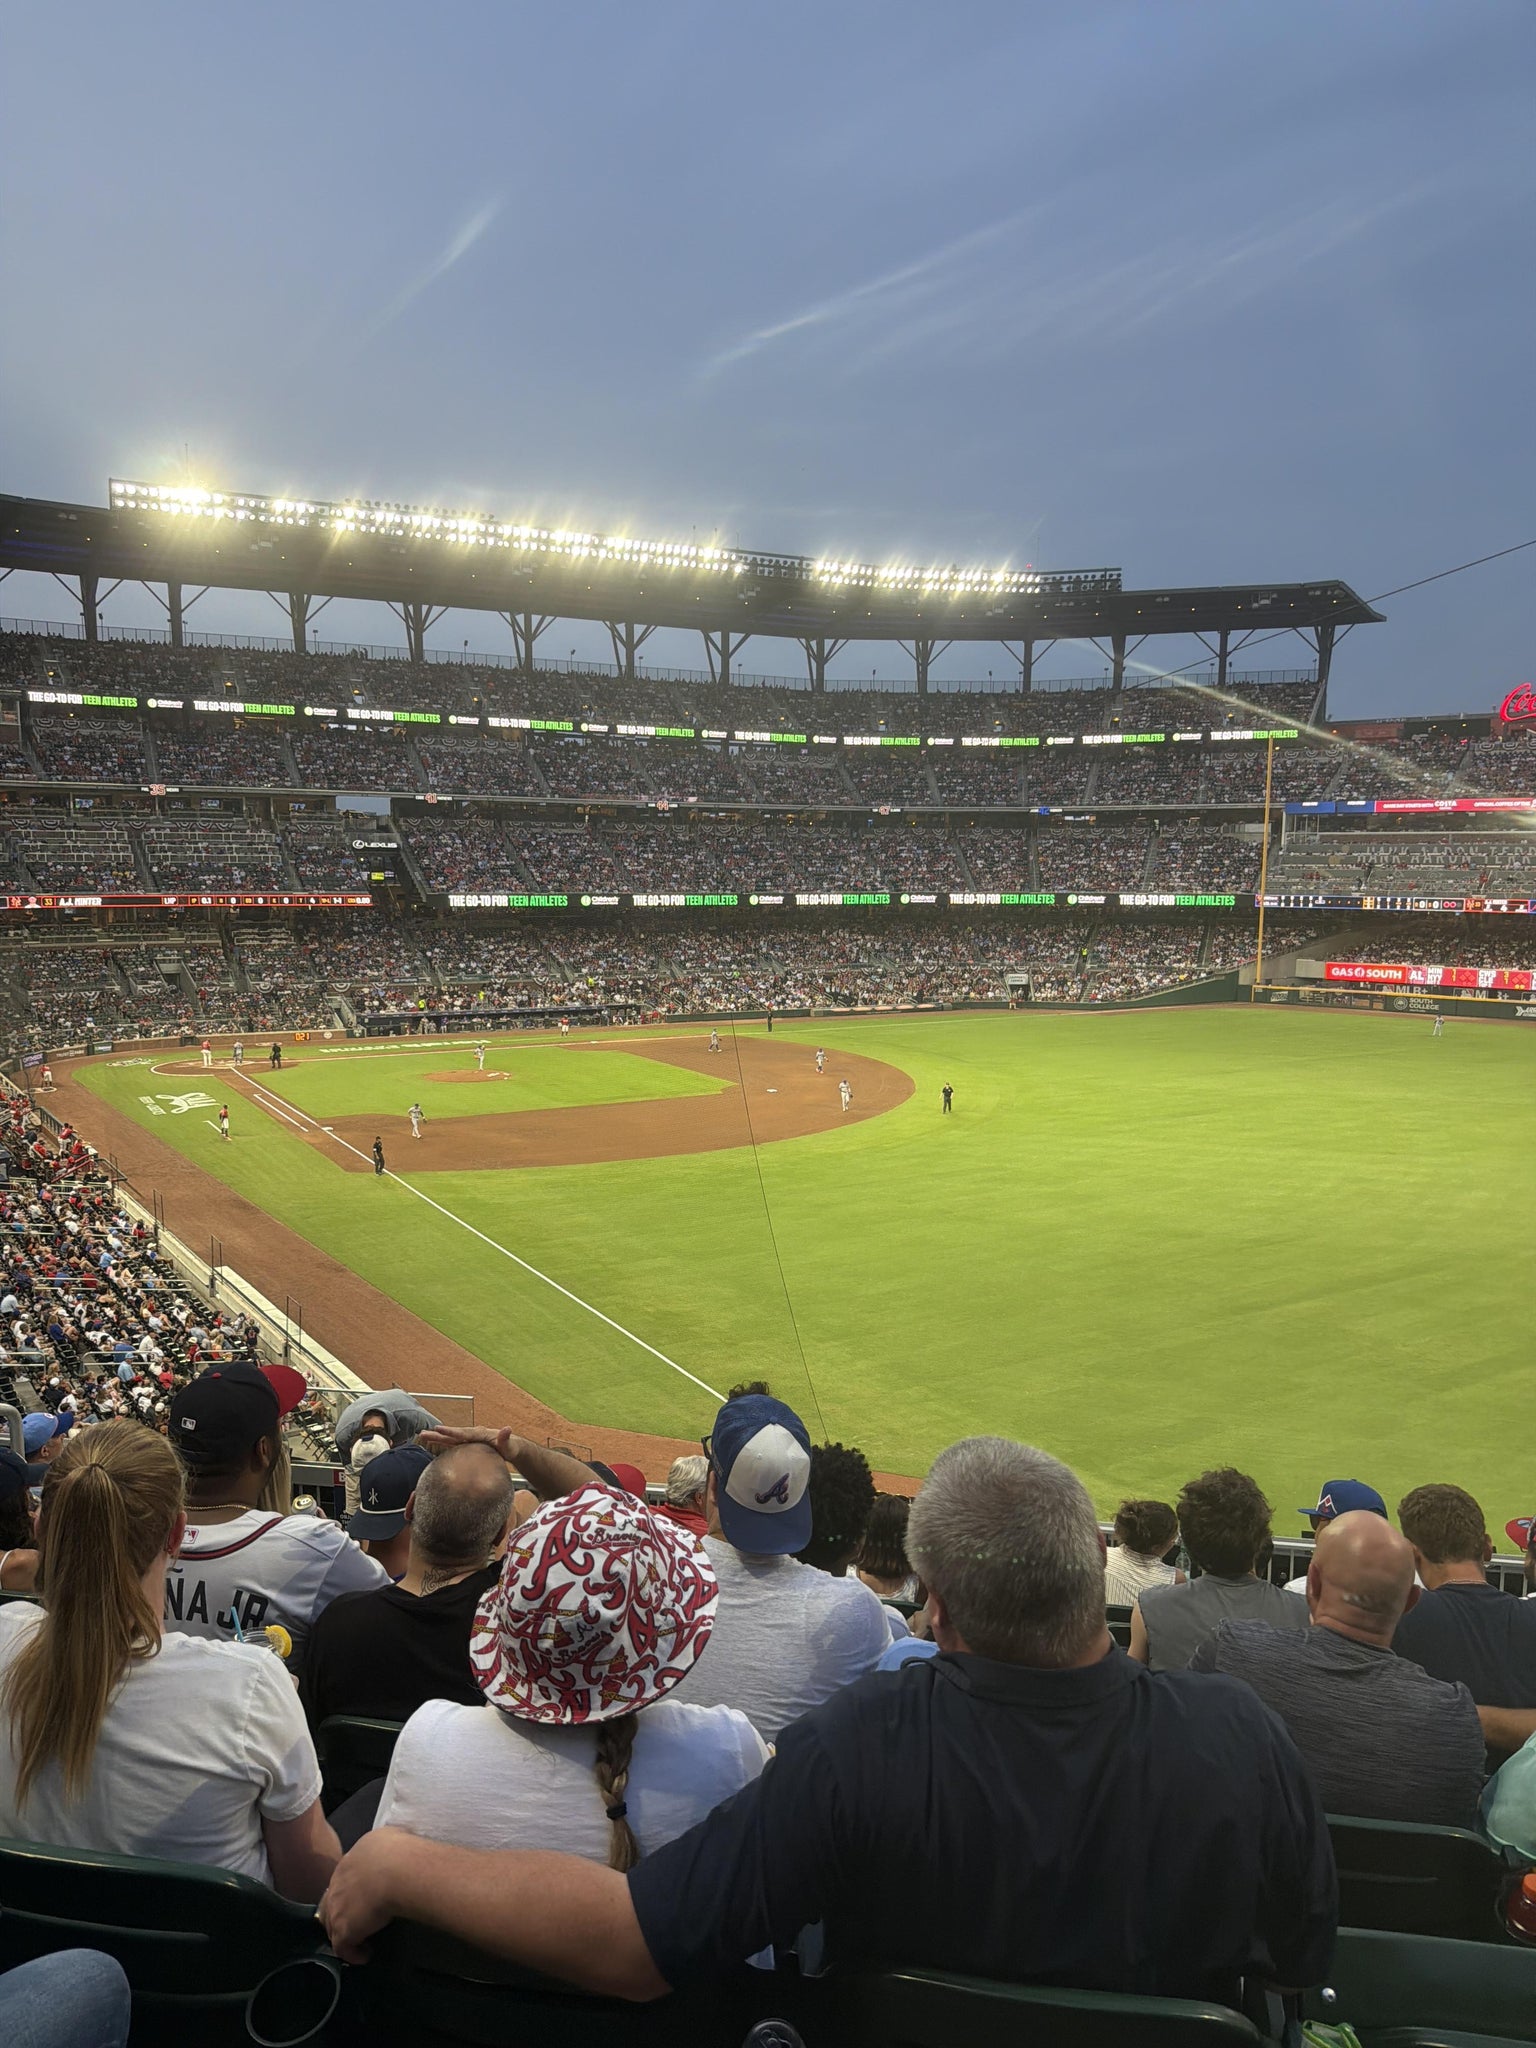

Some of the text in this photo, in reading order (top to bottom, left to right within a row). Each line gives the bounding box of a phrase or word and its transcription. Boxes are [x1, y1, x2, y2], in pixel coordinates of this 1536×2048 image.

[28, 691, 138, 706] THE GO-TO FOR TEEN ATHLETES
[194, 701, 295, 714] THE GO-TO FOR TEEN ATHLETES
[347, 709, 440, 722] THE GO-TO FOR TEEN ATHLETES
[488, 717, 573, 730] THE GO-TO FOR TEEN ATHLETES
[617, 725, 628, 734] THE
[628, 725, 644, 735] GO-TO
[645, 726, 655, 735] FOR
[1211, 732, 1223, 740] THE
[1223, 731, 1241, 740] GO-TO
[1242, 731, 1253, 739] FOR
[735, 731, 745, 740] THE
[745, 732, 760, 740] GO-TO
[761, 732, 770, 741] FOR
[783, 734, 806, 742] ATHLETES
[844, 737, 854, 745] THE
[855, 737, 870, 745] GO-TO
[871, 737, 880, 745] FOR
[962, 737, 972, 746] THE
[973, 737, 989, 746] GO-TO
[989, 738, 999, 746] FOR
[1082, 736, 1094, 744] THE
[1094, 735, 1111, 744] GO-TO
[1112, 735, 1122, 743] FOR
[150, 784, 166, 795] 35
[59, 898, 73, 906] A.J.
[74, 898, 102, 906] MINTER
[448, 895, 568, 906] THE GO-TO FOR TEEN ATHLETES
[633, 895, 738, 906] THE GO-TO FOR TEEN ATHLETES
[796, 894, 890, 905] THE GO-TO FOR TEEN ATHLETES
[949, 894, 1055, 904] THE GO-TO FOR TEEN ATHLETES
[1119, 895, 1235, 905] THE GO-TO FOR TEEN ATHLETES
[1332, 967, 1402, 979] GAS SOUTH
[1409, 970, 1424, 980] AL
[755, 1473, 790, 1504] A
[521, 1516, 594, 1601] A
[216, 1590, 268, 1630] JR
